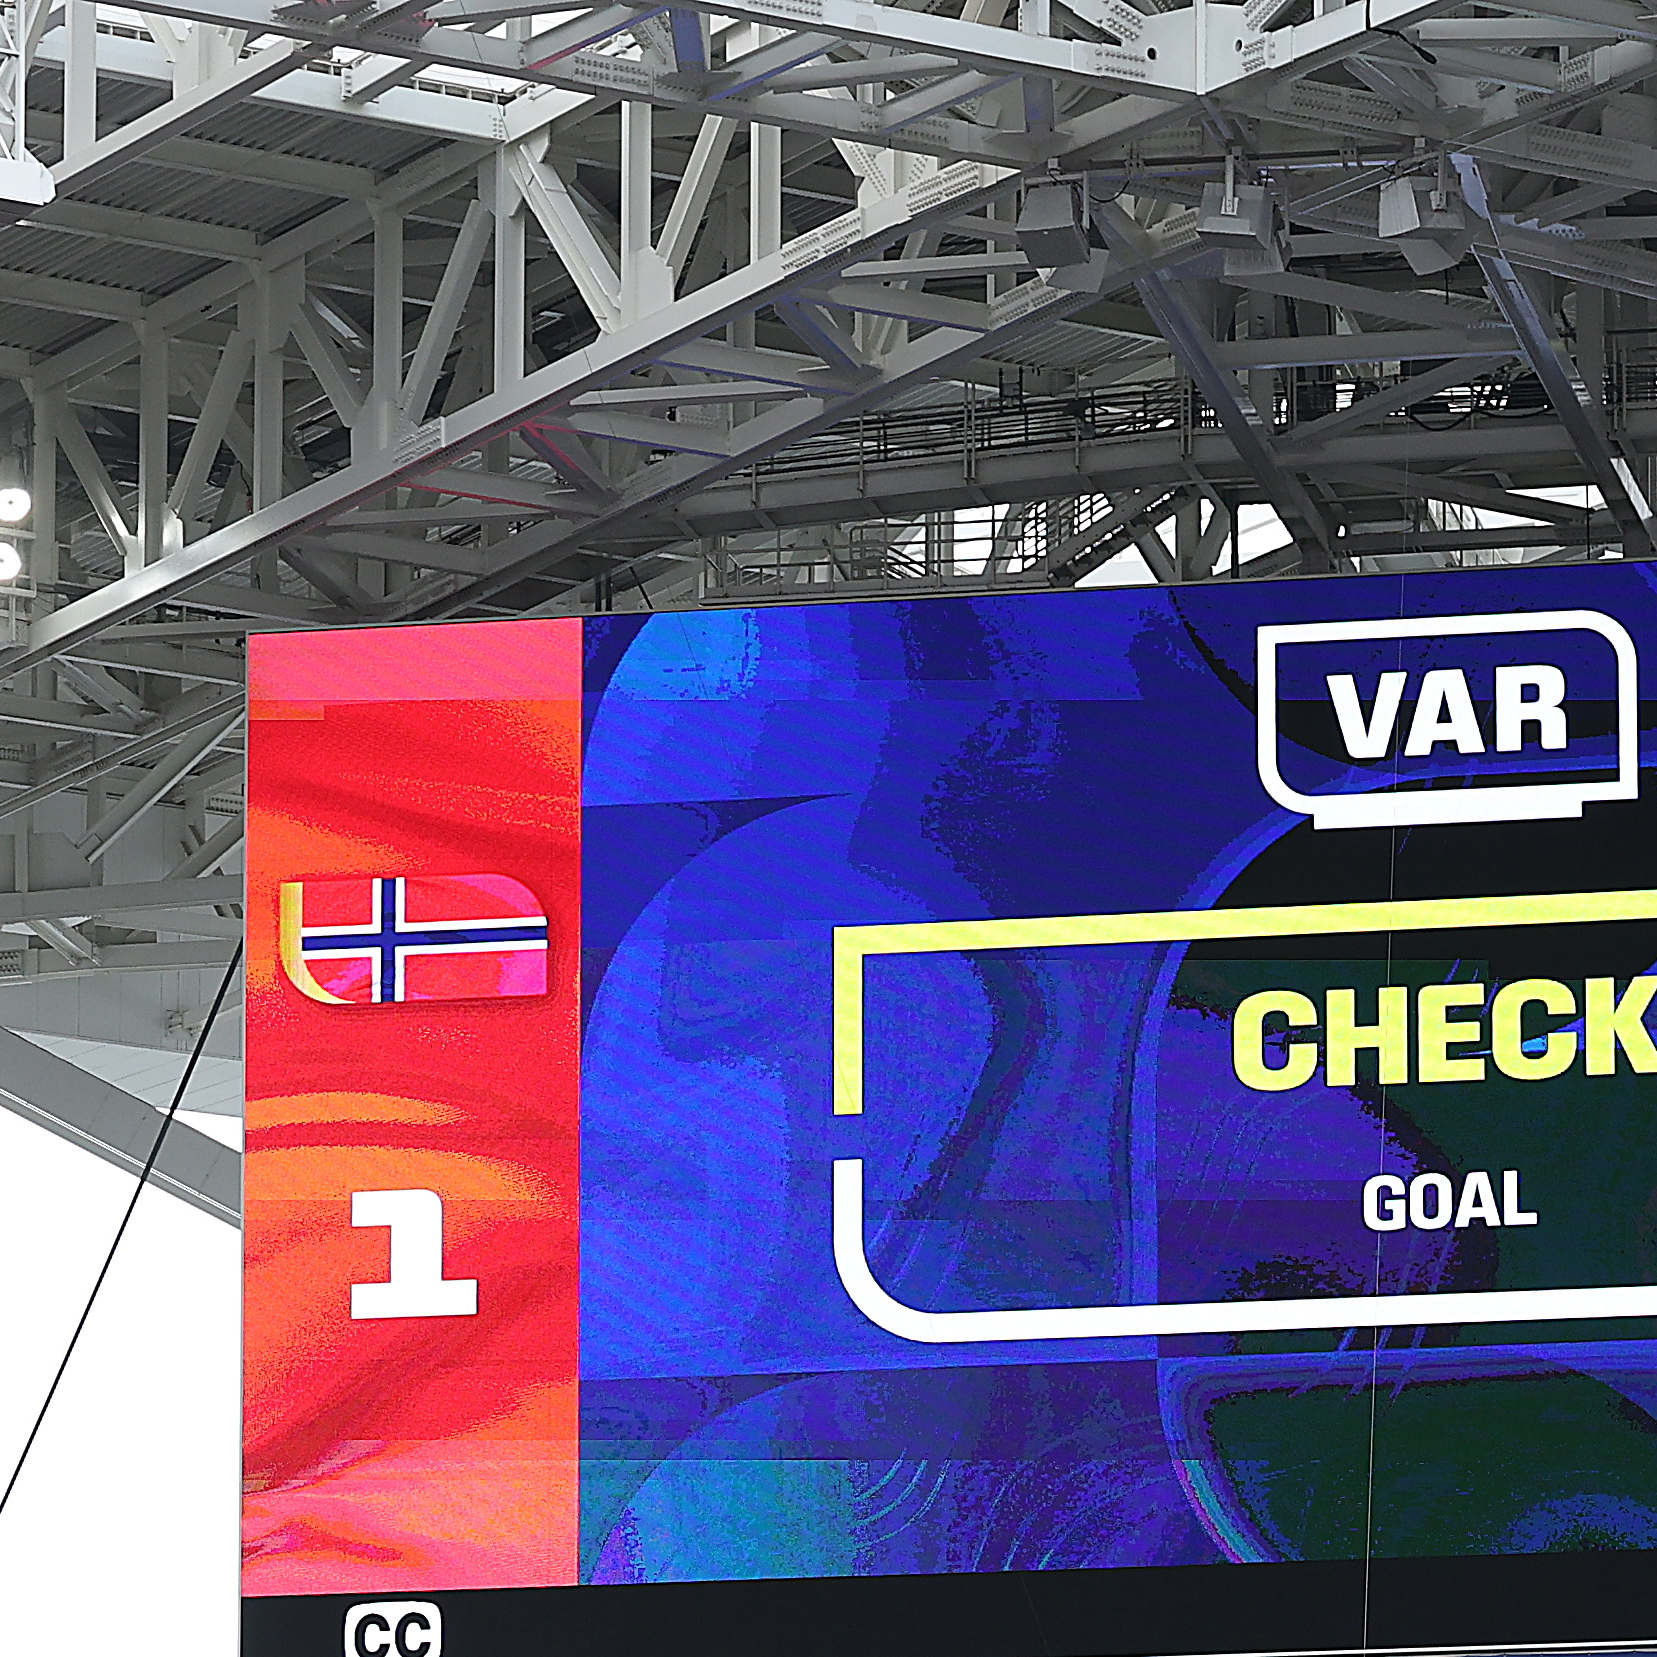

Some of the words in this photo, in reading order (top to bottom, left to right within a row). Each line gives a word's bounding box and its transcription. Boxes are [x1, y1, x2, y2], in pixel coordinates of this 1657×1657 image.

[1327, 665, 1567, 759] VAR
[1363, 1170, 1539, 1231] GOAL
[350, 1188, 477, 1320] 1
